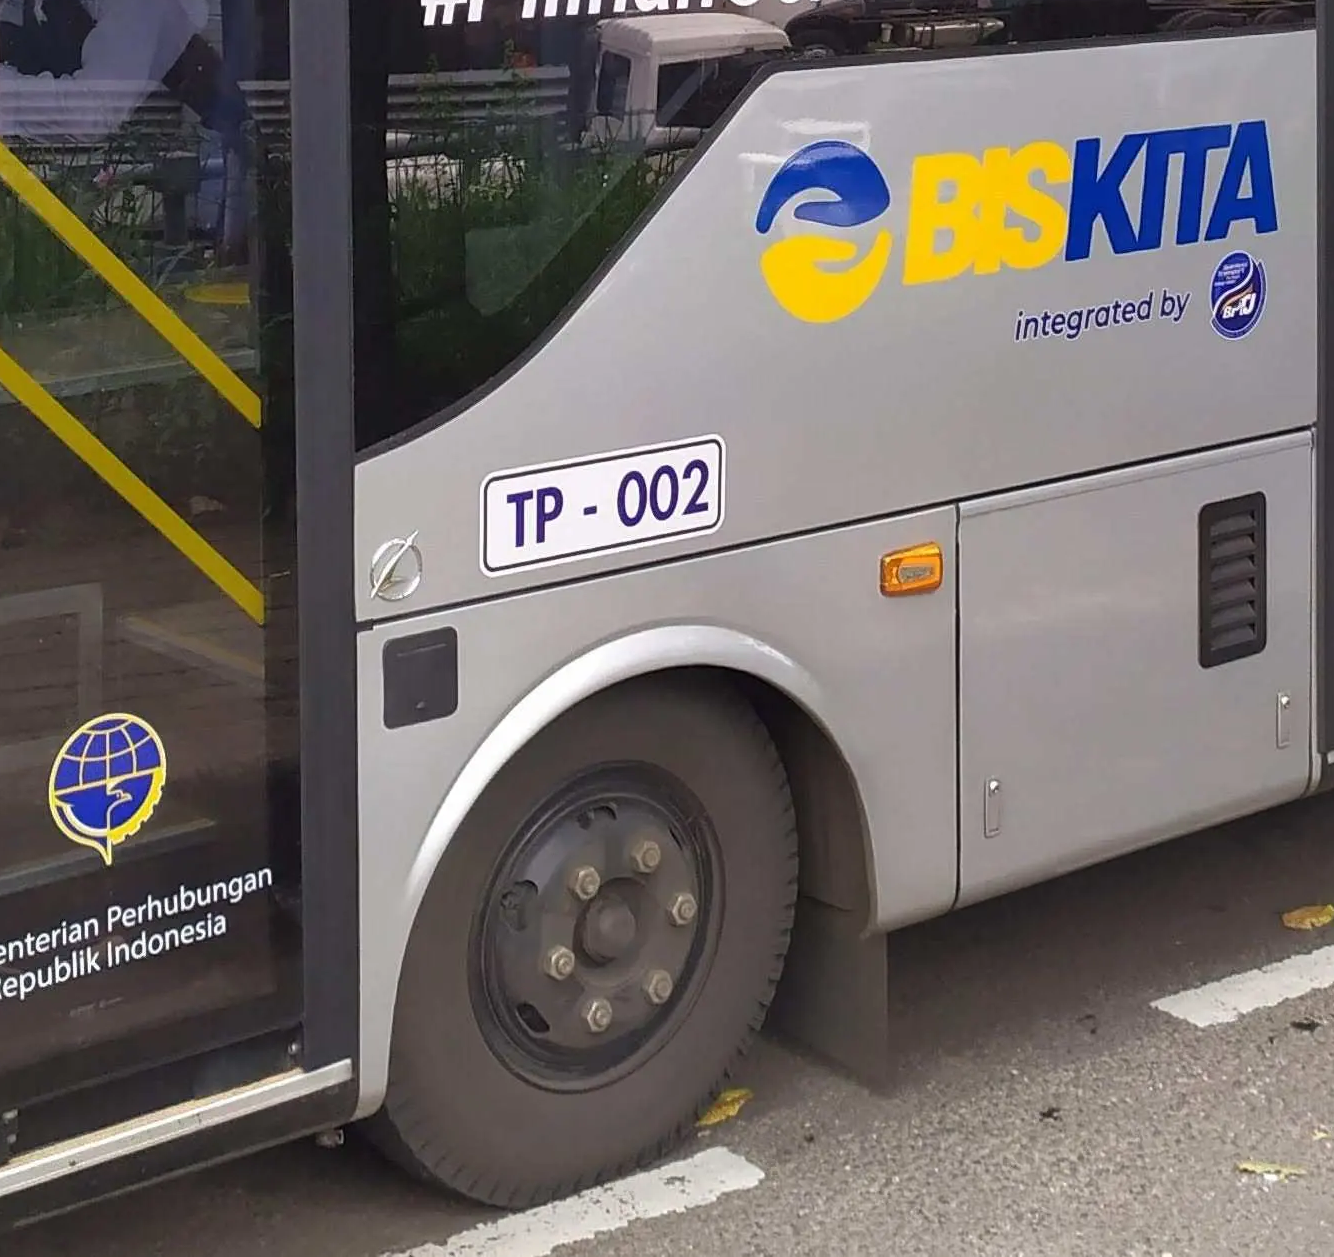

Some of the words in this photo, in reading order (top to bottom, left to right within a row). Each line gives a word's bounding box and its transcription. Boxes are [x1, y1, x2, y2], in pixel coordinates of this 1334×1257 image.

[901, 120, 1279, 285] BISKITA
[1014, 291, 1154, 341] integrated
[1160, 290, 1191, 322] by
[506, 486, 564, 548] TP
[616, 459, 709, 526] 002
[107, 865, 273, 937] Perhubungan
[106, 911, 227, 970] Indonesia
